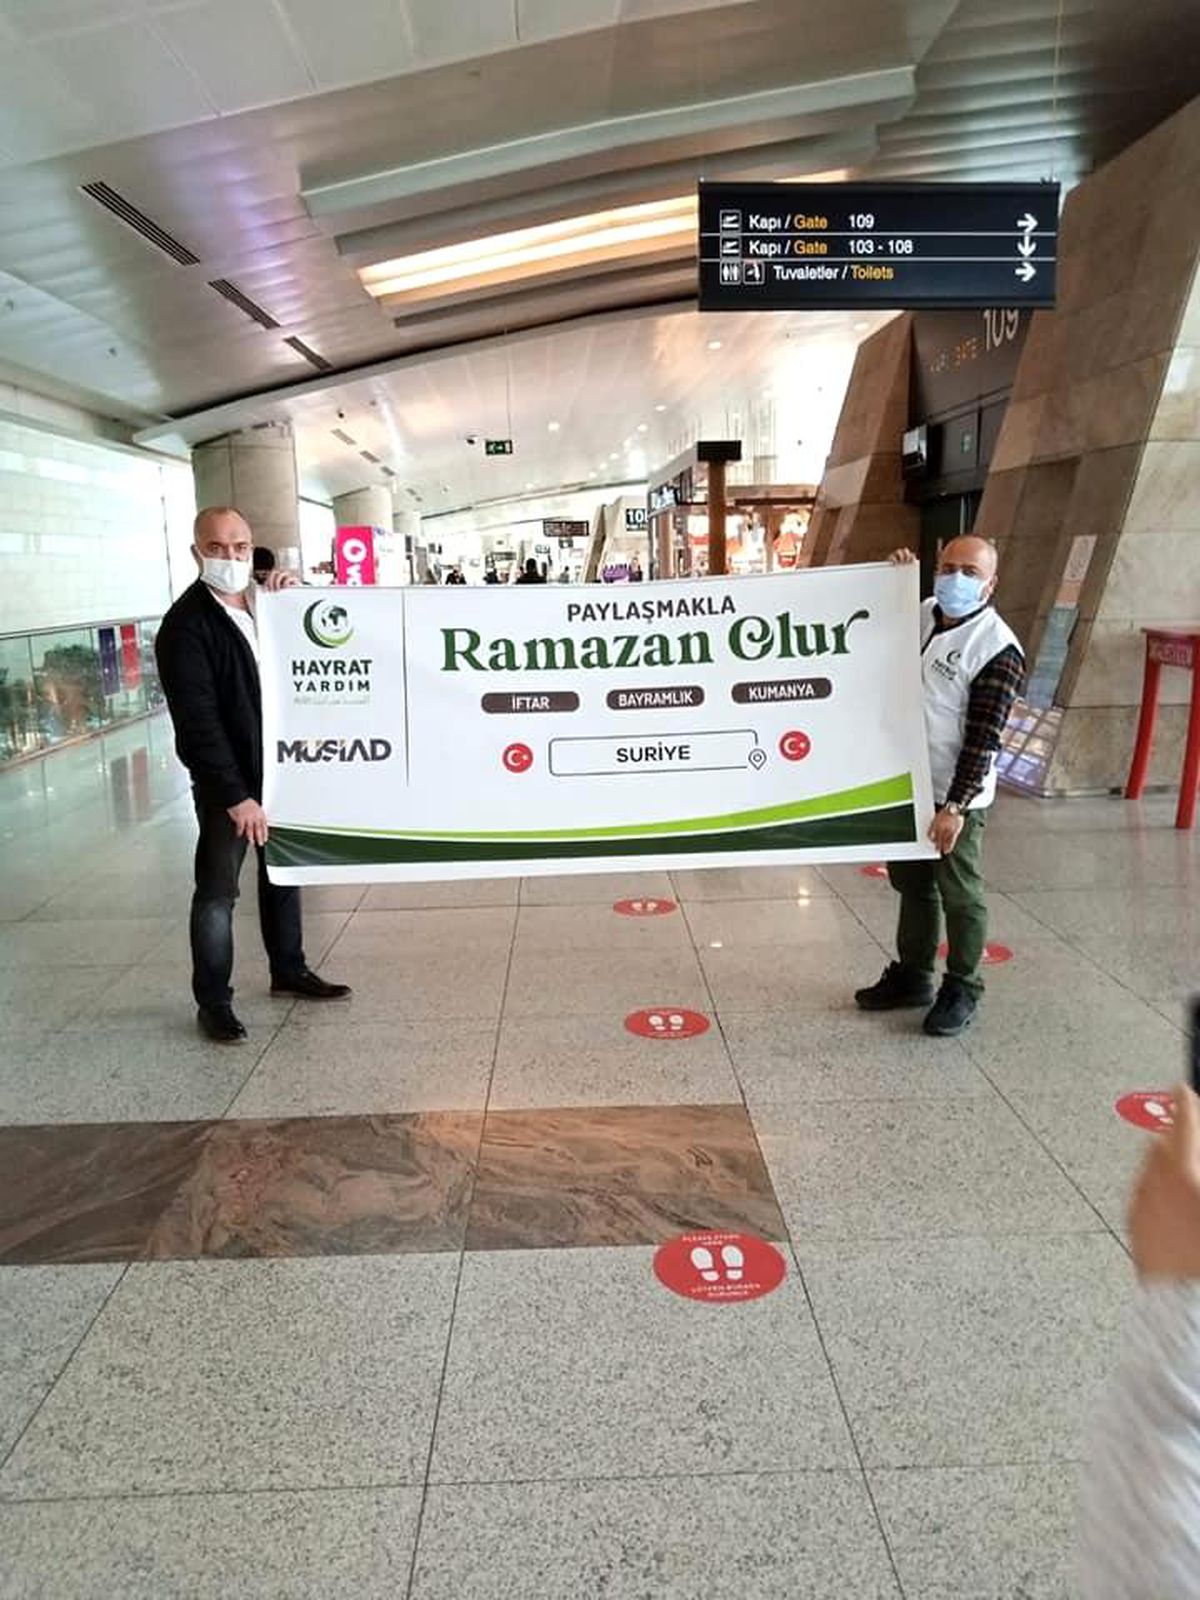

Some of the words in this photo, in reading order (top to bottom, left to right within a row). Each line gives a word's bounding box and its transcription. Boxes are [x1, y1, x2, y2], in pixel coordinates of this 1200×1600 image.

[749, 214, 781, 232] Kapı
[794, 214, 828, 230] Gate
[849, 214, 875, 230] 109
[749, 240, 781, 257] Kapı
[794, 240, 828, 255] Gate
[849, 239, 874, 254] 103
[888, 239, 913, 254] 108
[773, 265, 839, 280] Tuvaletler
[851, 265, 894, 280] Toilets
[567, 595, 736, 624] PAYLAŞMAKLA
[440, 627, 714, 672] Ramazan
[728, 609, 870, 661] Olur
[292, 659, 372, 676] HAYRAT
[293, 680, 370, 692] YARDIM
[748, 683, 815, 701] KUMANYA
[511, 695, 550, 710] İFTAR
[618, 690, 694, 707] BAYRAMLIK
[616, 742, 690, 763] SURİYE
